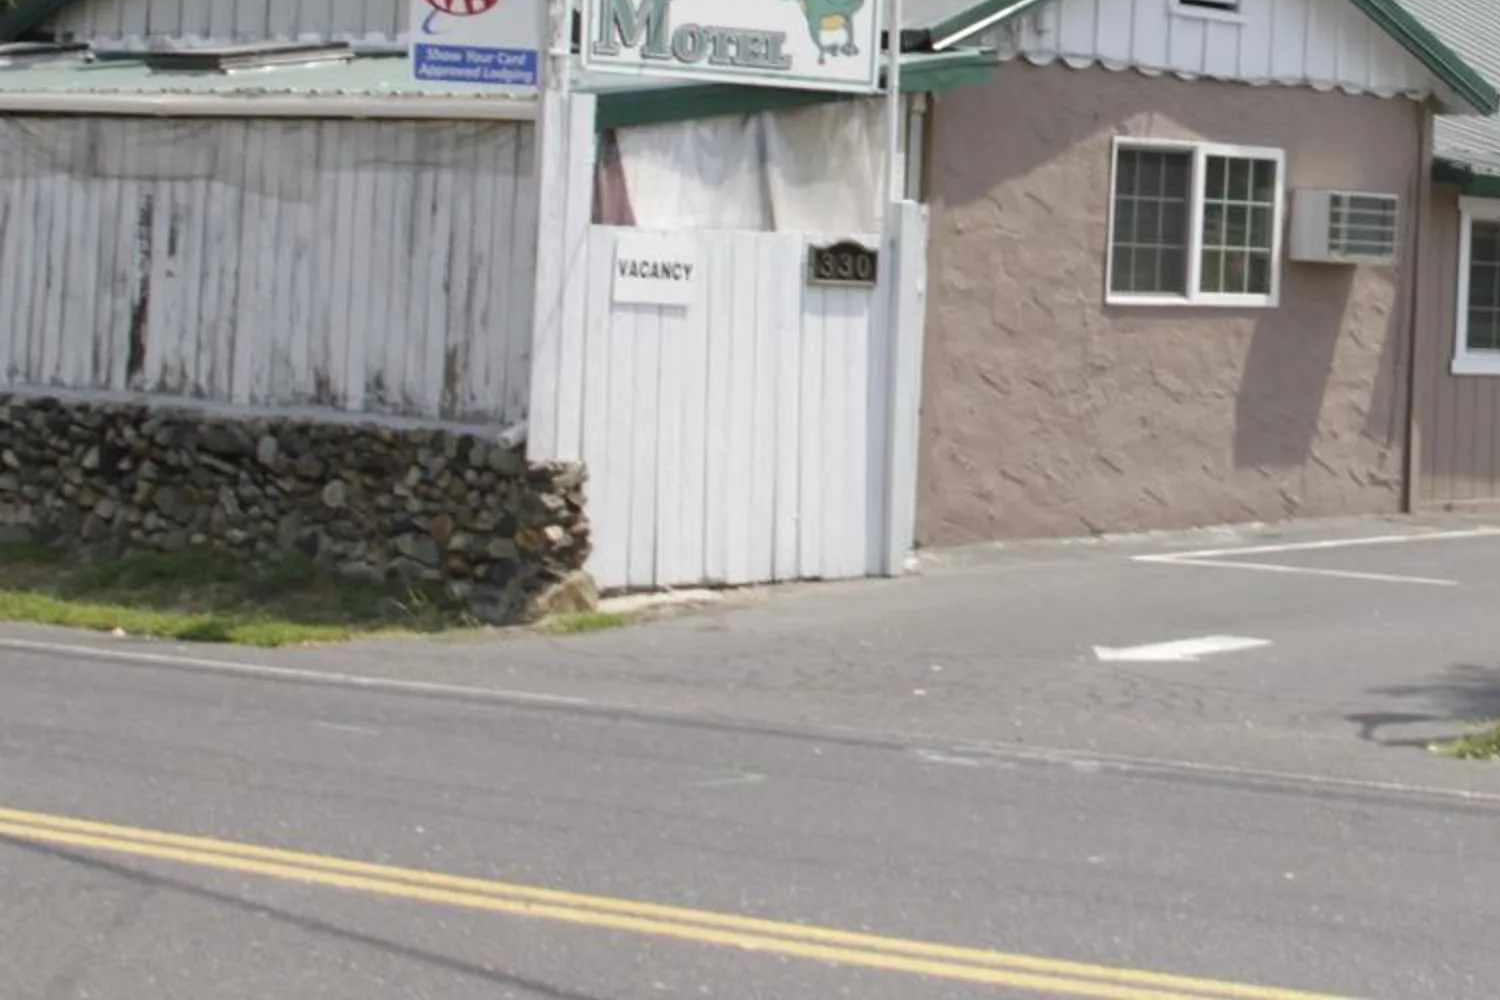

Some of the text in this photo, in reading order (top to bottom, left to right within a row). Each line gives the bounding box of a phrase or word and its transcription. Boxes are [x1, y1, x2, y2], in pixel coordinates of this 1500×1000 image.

[426, 47, 527, 66] Show Your Card
[618, 258, 694, 281] VACANCY
[820, 252, 872, 278] 330
